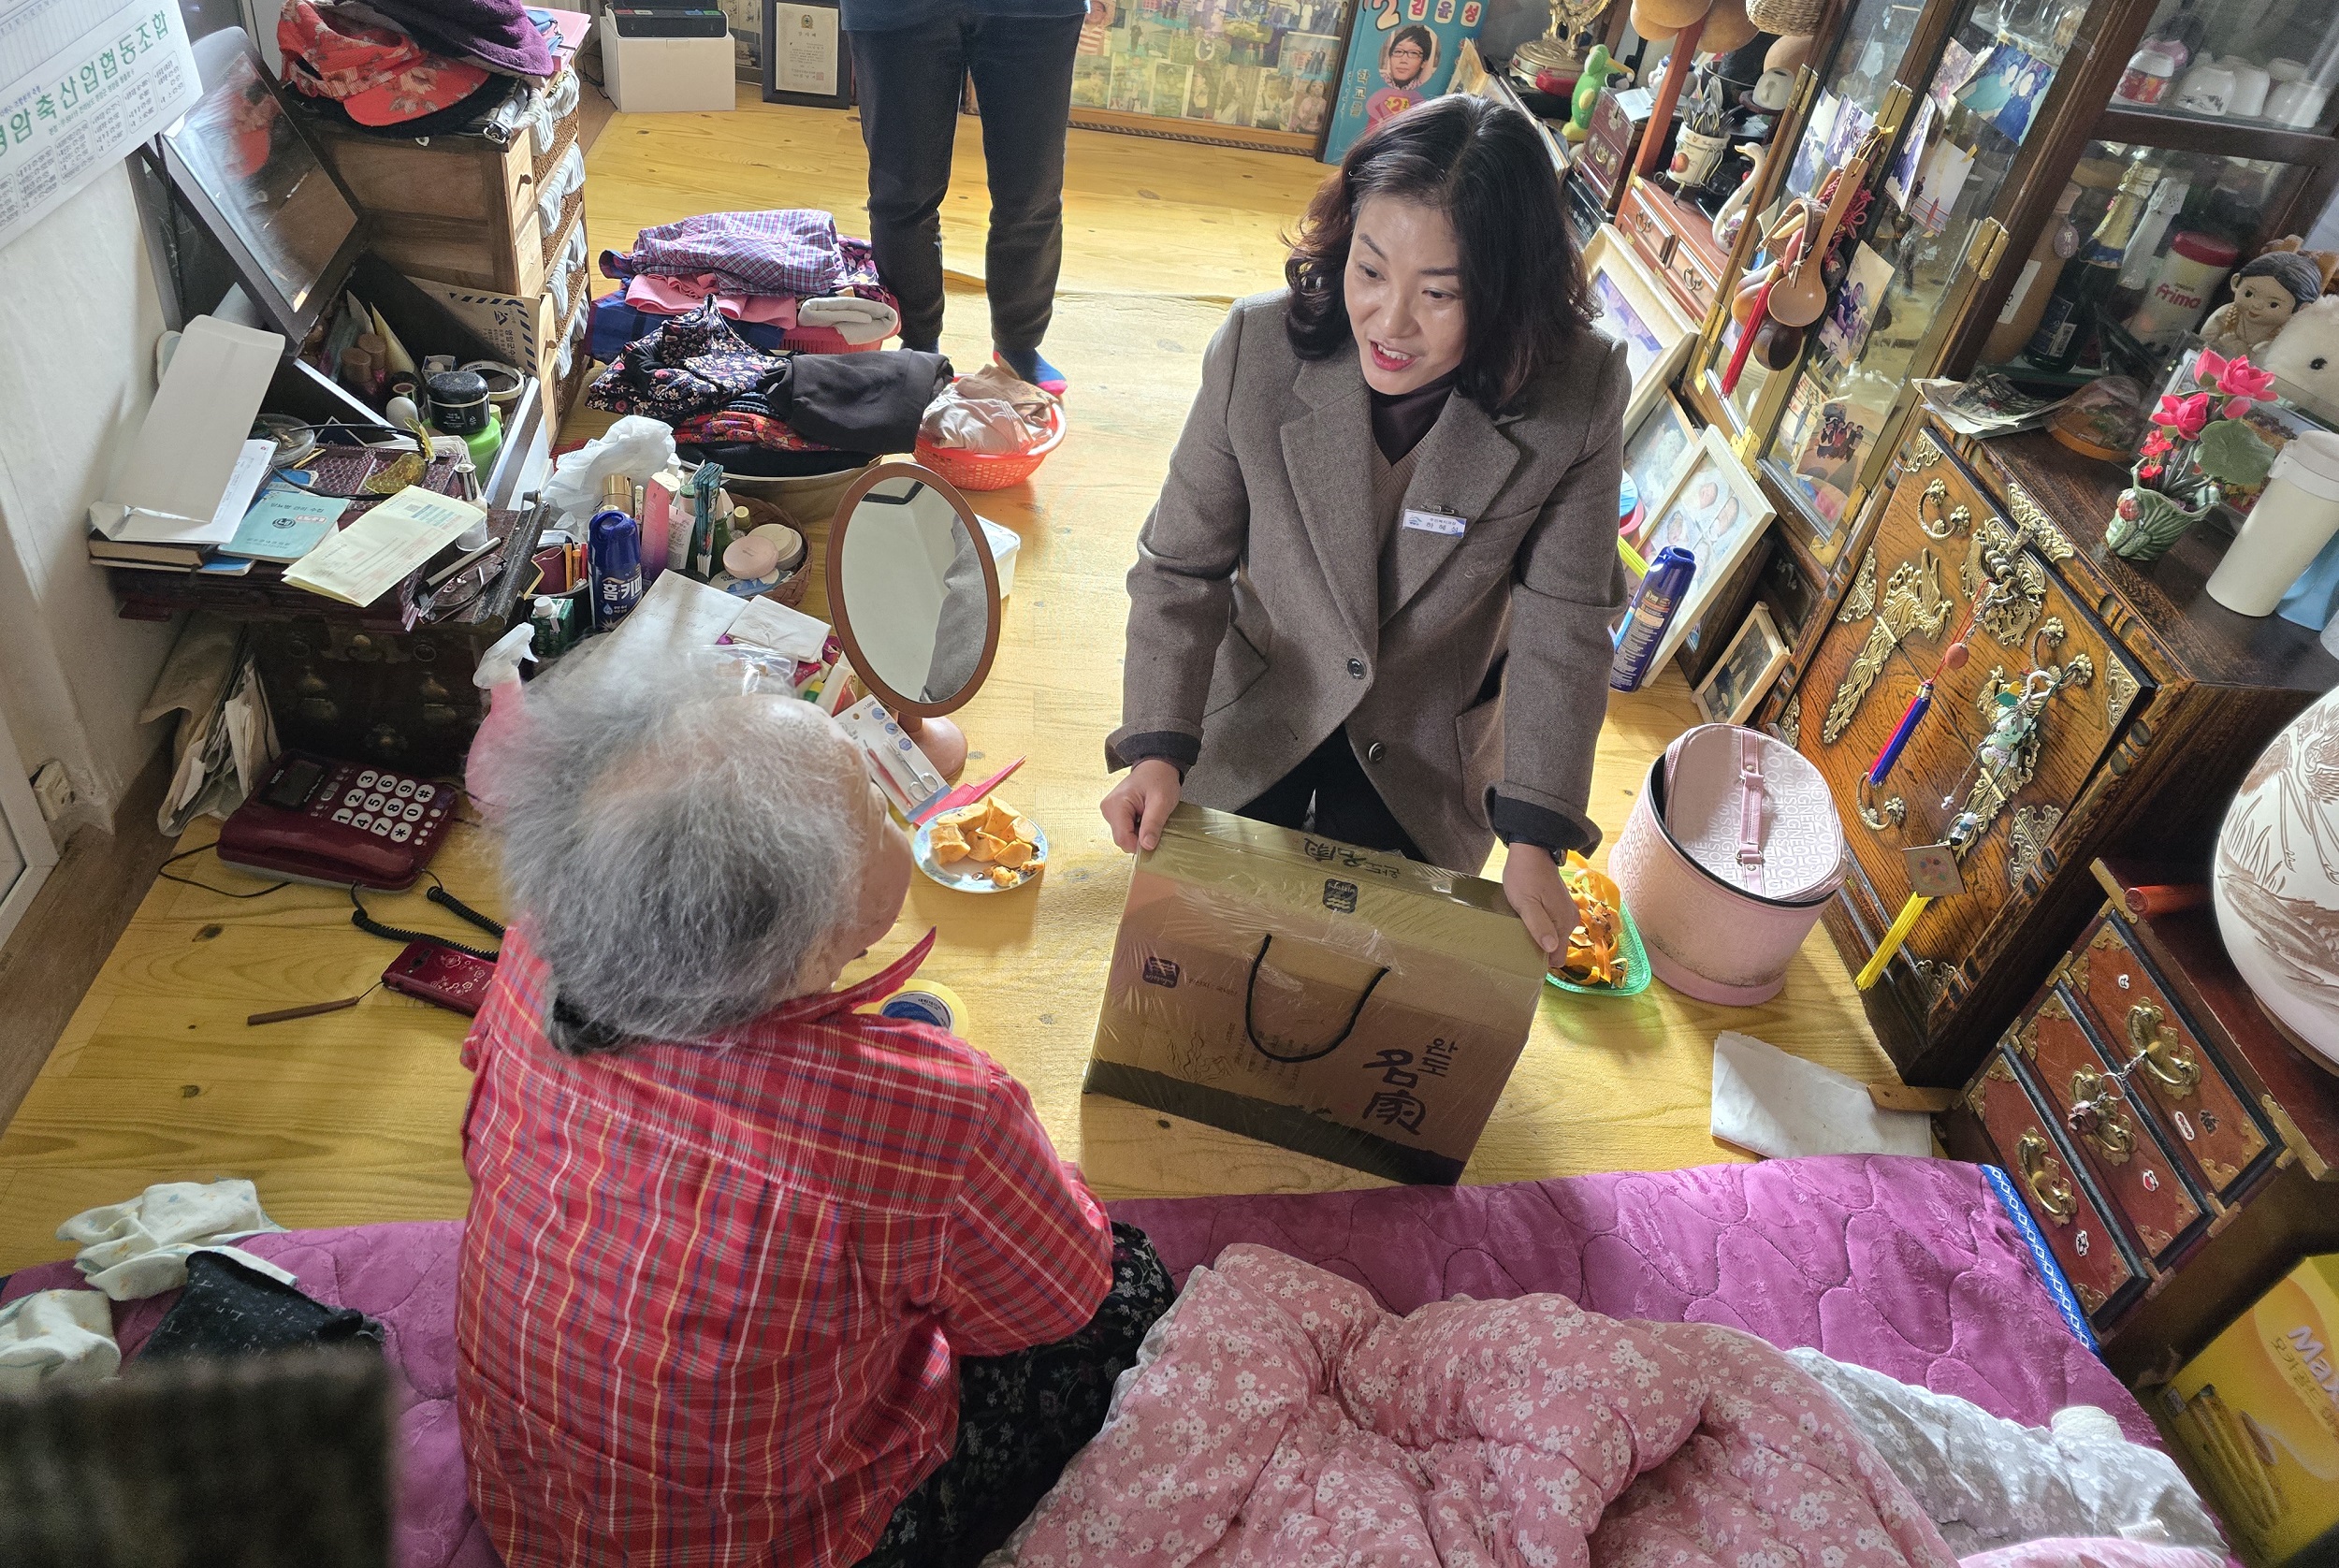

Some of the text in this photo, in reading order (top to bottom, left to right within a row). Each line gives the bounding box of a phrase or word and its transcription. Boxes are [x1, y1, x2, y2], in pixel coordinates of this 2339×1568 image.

[348, 793, 361, 804] 2
[360, 775, 373, 784] 3
[356, 779, 393, 827] 4 5 6
[375, 784, 413, 832] 7 8 9
[407, 807, 418, 818] 0
[1366, 861, 1402, 879] 완도
[1417, 1037, 1460, 1079] 완도
